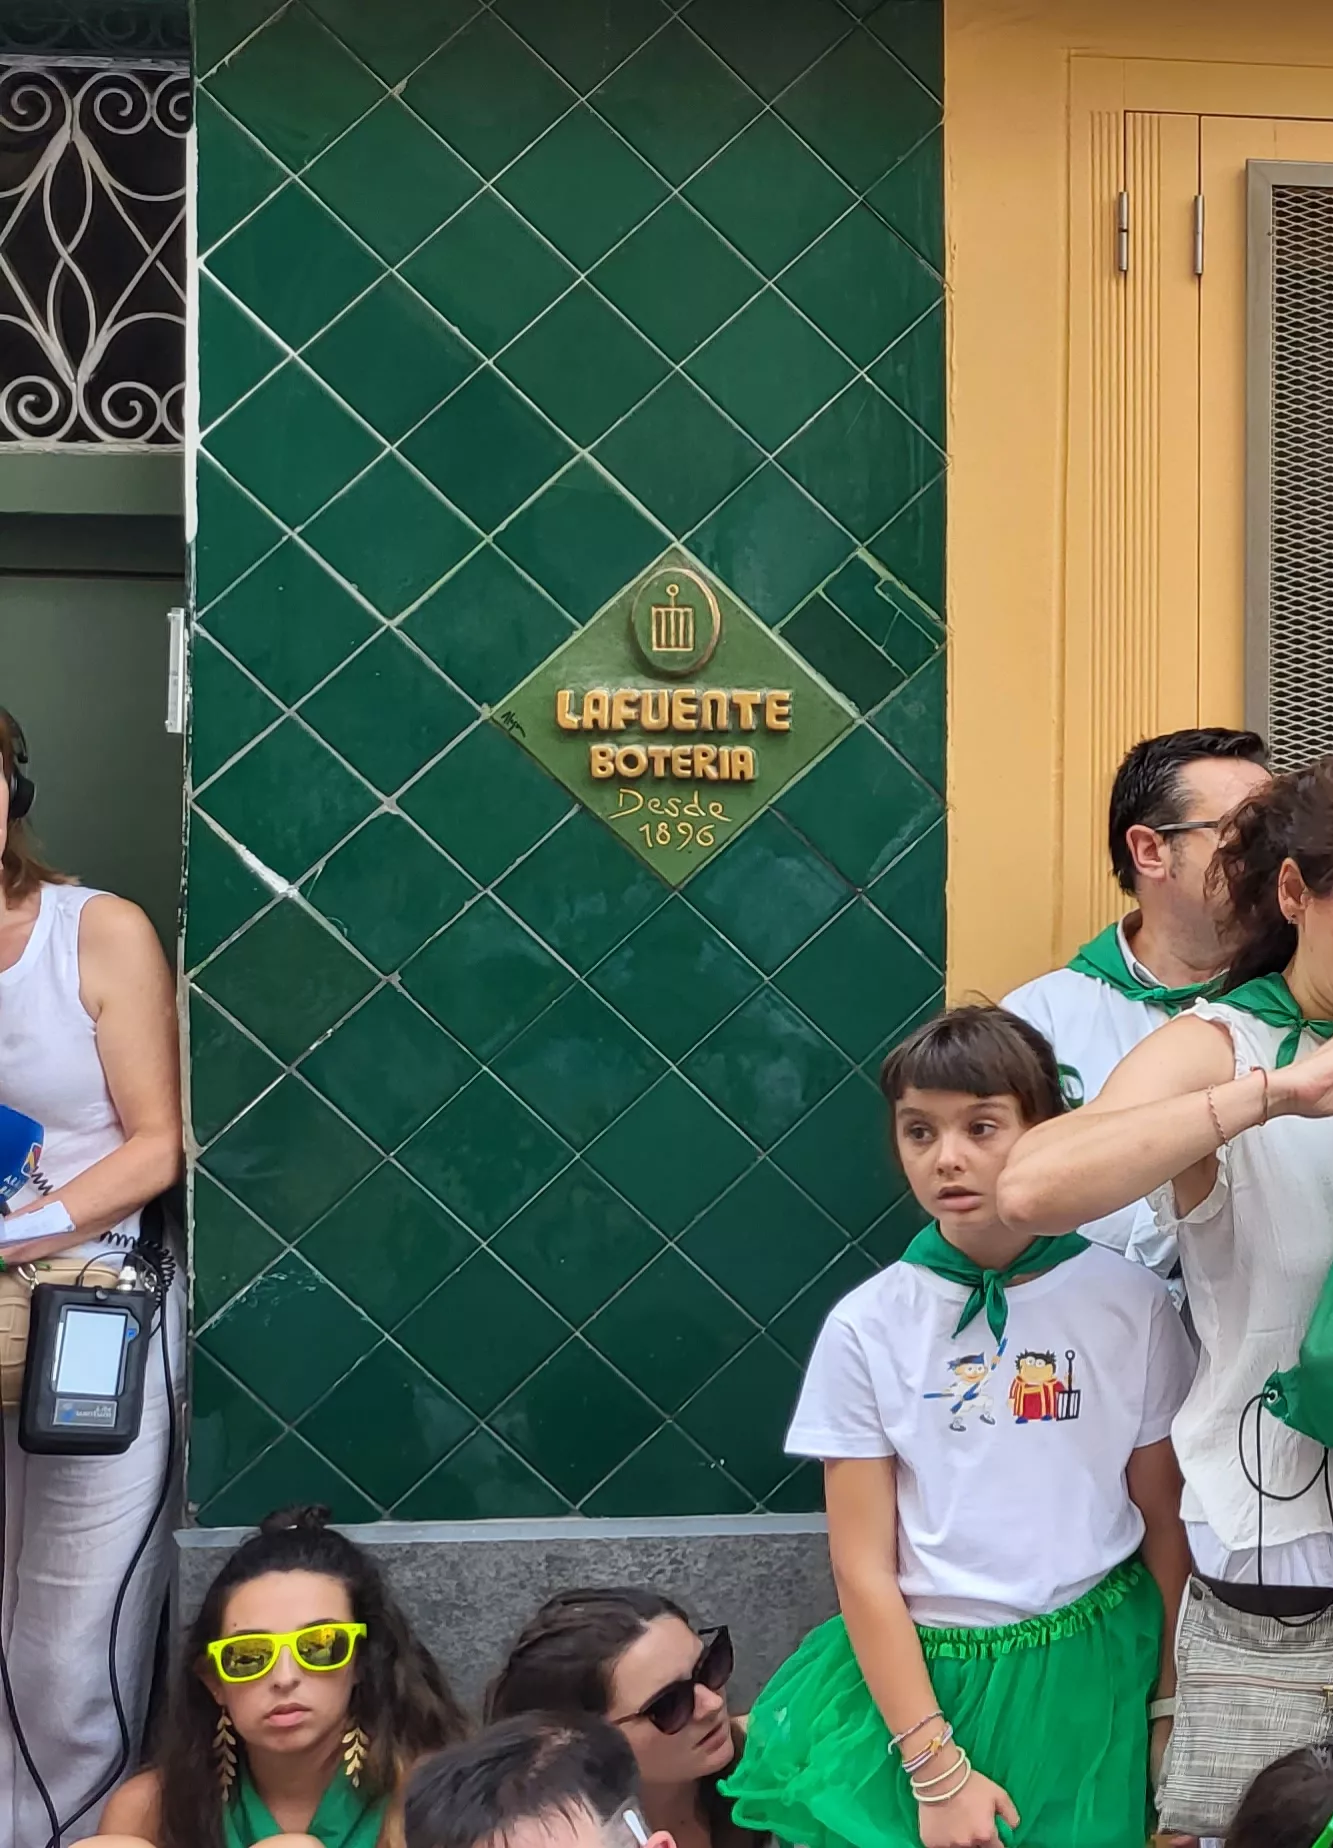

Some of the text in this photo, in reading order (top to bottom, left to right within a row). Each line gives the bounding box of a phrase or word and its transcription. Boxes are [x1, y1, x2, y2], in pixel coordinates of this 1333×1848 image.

[556, 688, 793, 731] LAFUENTE
[590, 744, 757, 781] BOTERIA
[608, 788, 732, 822] Desde
[639, 821, 716, 850] 1896
